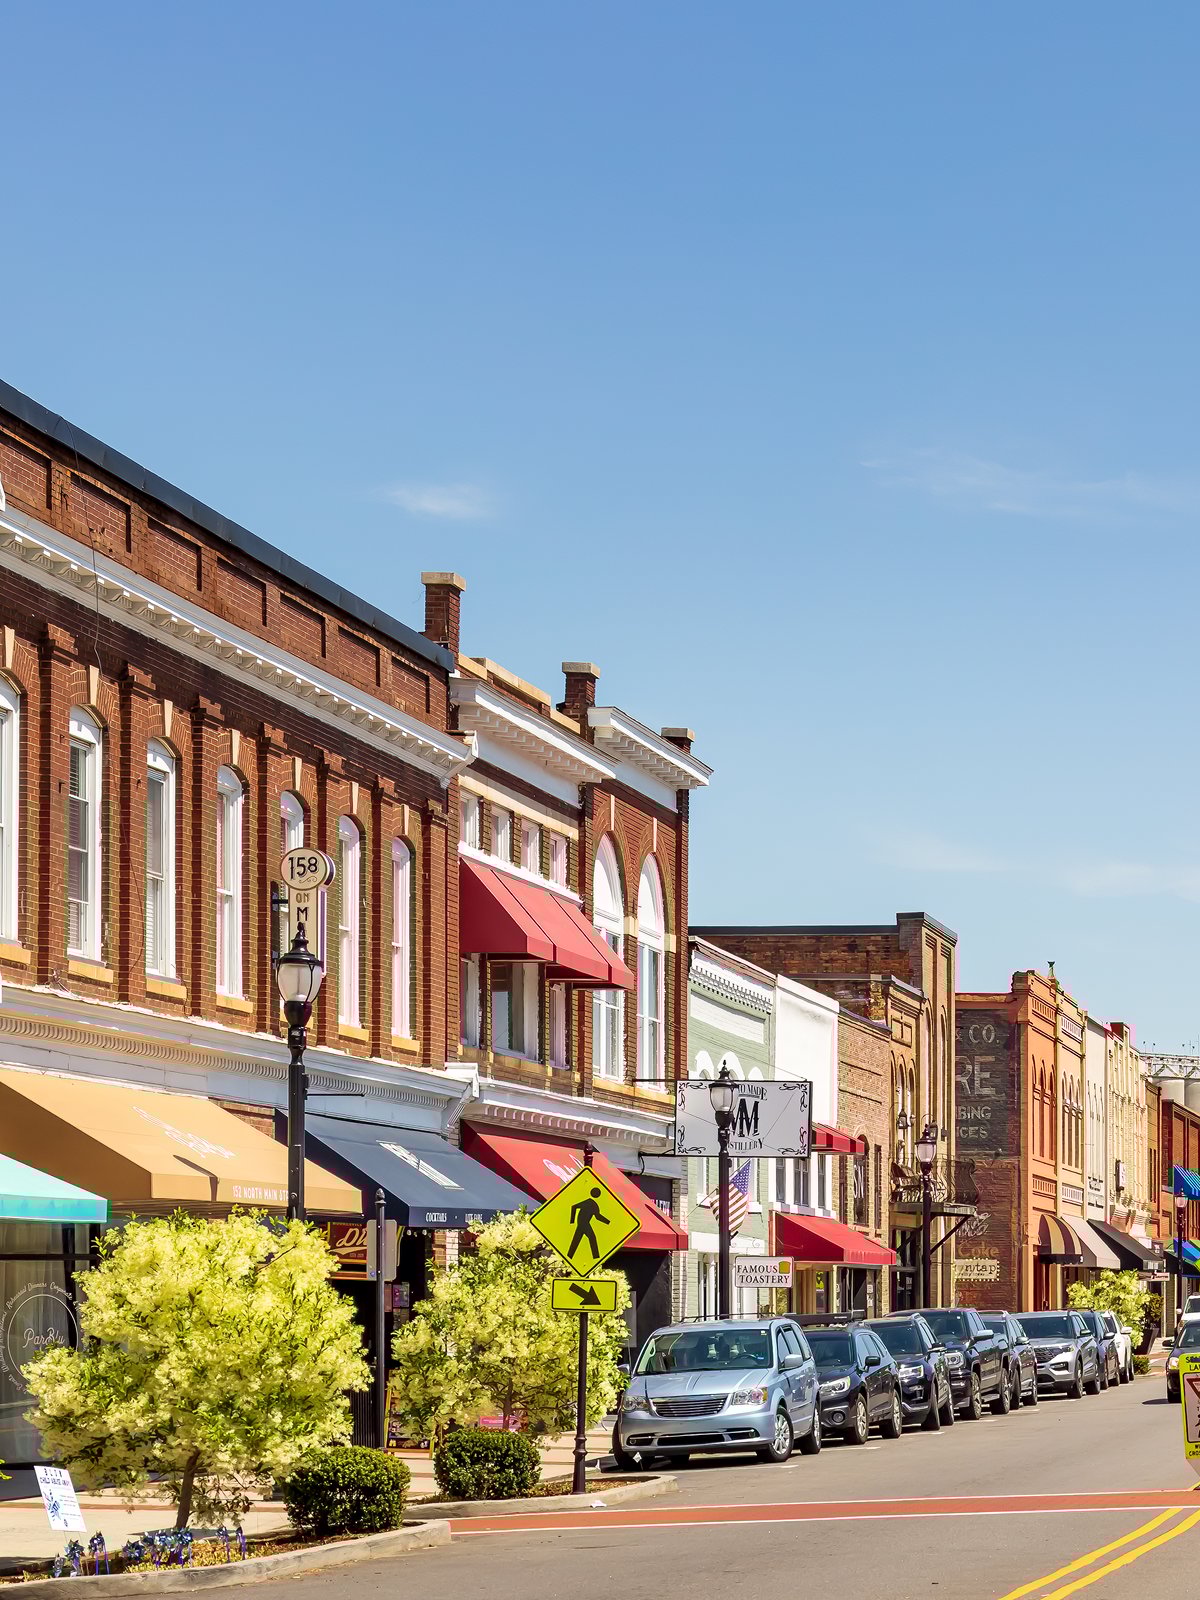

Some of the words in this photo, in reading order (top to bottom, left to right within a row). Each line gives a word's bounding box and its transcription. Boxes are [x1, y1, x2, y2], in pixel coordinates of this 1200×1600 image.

[289, 856, 318, 880] 158
[243, 1186, 263, 1200] NORTH
[263, 1188, 278, 1201] MAIN
[736, 1264, 778, 1274] FAMOUS
[739, 1274, 790, 1284] TOASTERY
